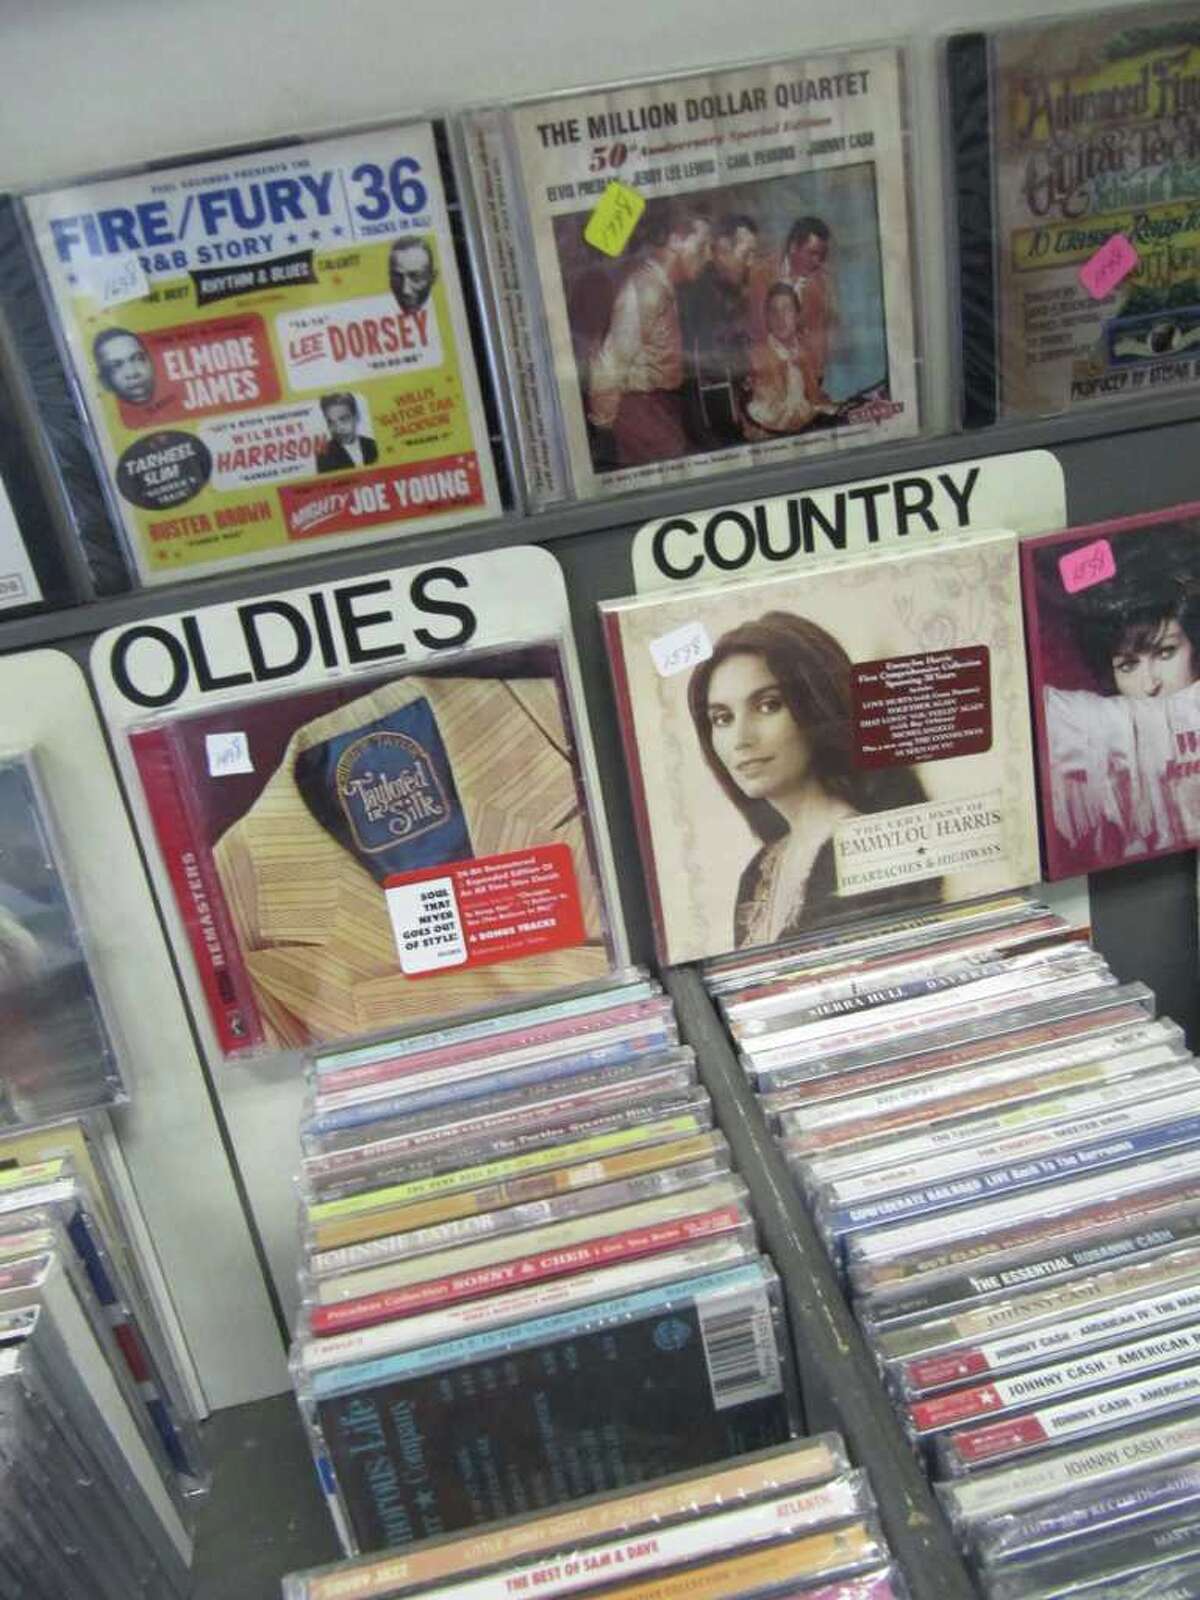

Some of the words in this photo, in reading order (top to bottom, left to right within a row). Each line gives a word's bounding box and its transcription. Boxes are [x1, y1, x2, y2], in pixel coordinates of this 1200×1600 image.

[537, 118, 581, 148] THE
[587, 102, 678, 140] MILLION
[685, 87, 768, 122] DOLLAR
[774, 70, 870, 110] QUARTET
[352, 156, 428, 221] 36
[546, 184, 576, 203] ELVIS
[849, 131, 875, 148] CASH
[49, 170, 334, 264] FIRE/FURY
[197, 232, 274, 265] STORY
[289, 331, 325, 362] LEE
[327, 309, 429, 363] DORSEY
[161, 336, 260, 382] ELMORE
[183, 370, 261, 412] JAMES
[216, 433, 329, 475] HARRISON
[232, 421, 305, 446] WILBERT
[125, 441, 197, 477] TARHEEL
[143, 463, 181, 488] SLIM
[149, 512, 214, 543] BUSTER
[214, 499, 273, 531] BROWN
[291, 491, 349, 531] MIGHTY
[350, 481, 391, 517] JOE
[394, 467, 471, 508] YOUNG
[652, 467, 980, 580] COUNTRY
[110, 566, 477, 708] OLDIES
[388, 791, 444, 836] Silk
[839, 827, 931, 858] EMMYLOU
[937, 809, 1002, 839] HARRIS
[852, 823, 884, 837] THE
[887, 814, 923, 831] VERY
[928, 805, 965, 820] BEST
[966, 802, 984, 812] OF
[841, 860, 923, 887] HEARTACHES
[936, 843, 1002, 867] HIGHWAYS
[181, 851, 225, 967] REMASTERS
[420, 888, 449, 902] SOUL
[422, 899, 451, 913] THAT
[402, 925, 432, 941] GOES
[434, 921, 456, 935] OUT
[418, 910, 453, 926] NEVER
[479, 923, 516, 941] BONUS
[518, 916, 558, 933] TRACKS
[404, 941, 420, 952] OF
[808, 996, 866, 1017] SIERRA
[866, 986, 905, 1004] HULL
[451, 1265, 515, 1291] SONNY
[540, 1249, 591, 1270] CHER
[968, 1275, 1001, 1293] THE
[1001, 1255, 1074, 1285] ESSENTIAL
[1135, 1229, 1177, 1247] CASH
[1039, 1332, 1071, 1348] CASH
[1155, 1301, 1178, 1315] THE
[1008, 1371, 1064, 1398] JOHNNY
[1066, 1360, 1109, 1381] CASH
[1115, 1337, 1190, 1367] AMERICAN
[1051, 1407, 1096, 1429] JOHNNY
[1098, 1397, 1132, 1415] CASH
[1063, 1450, 1123, 1478] JOHNNY
[1122, 1436, 1166, 1460] CASH
[506, 1575, 529, 1592] THE
[530, 1567, 561, 1586] BEST
[564, 1560, 581, 1577] OF
[582, 1553, 612, 1572] SAM
[627, 1539, 659, 1562] DAVE
